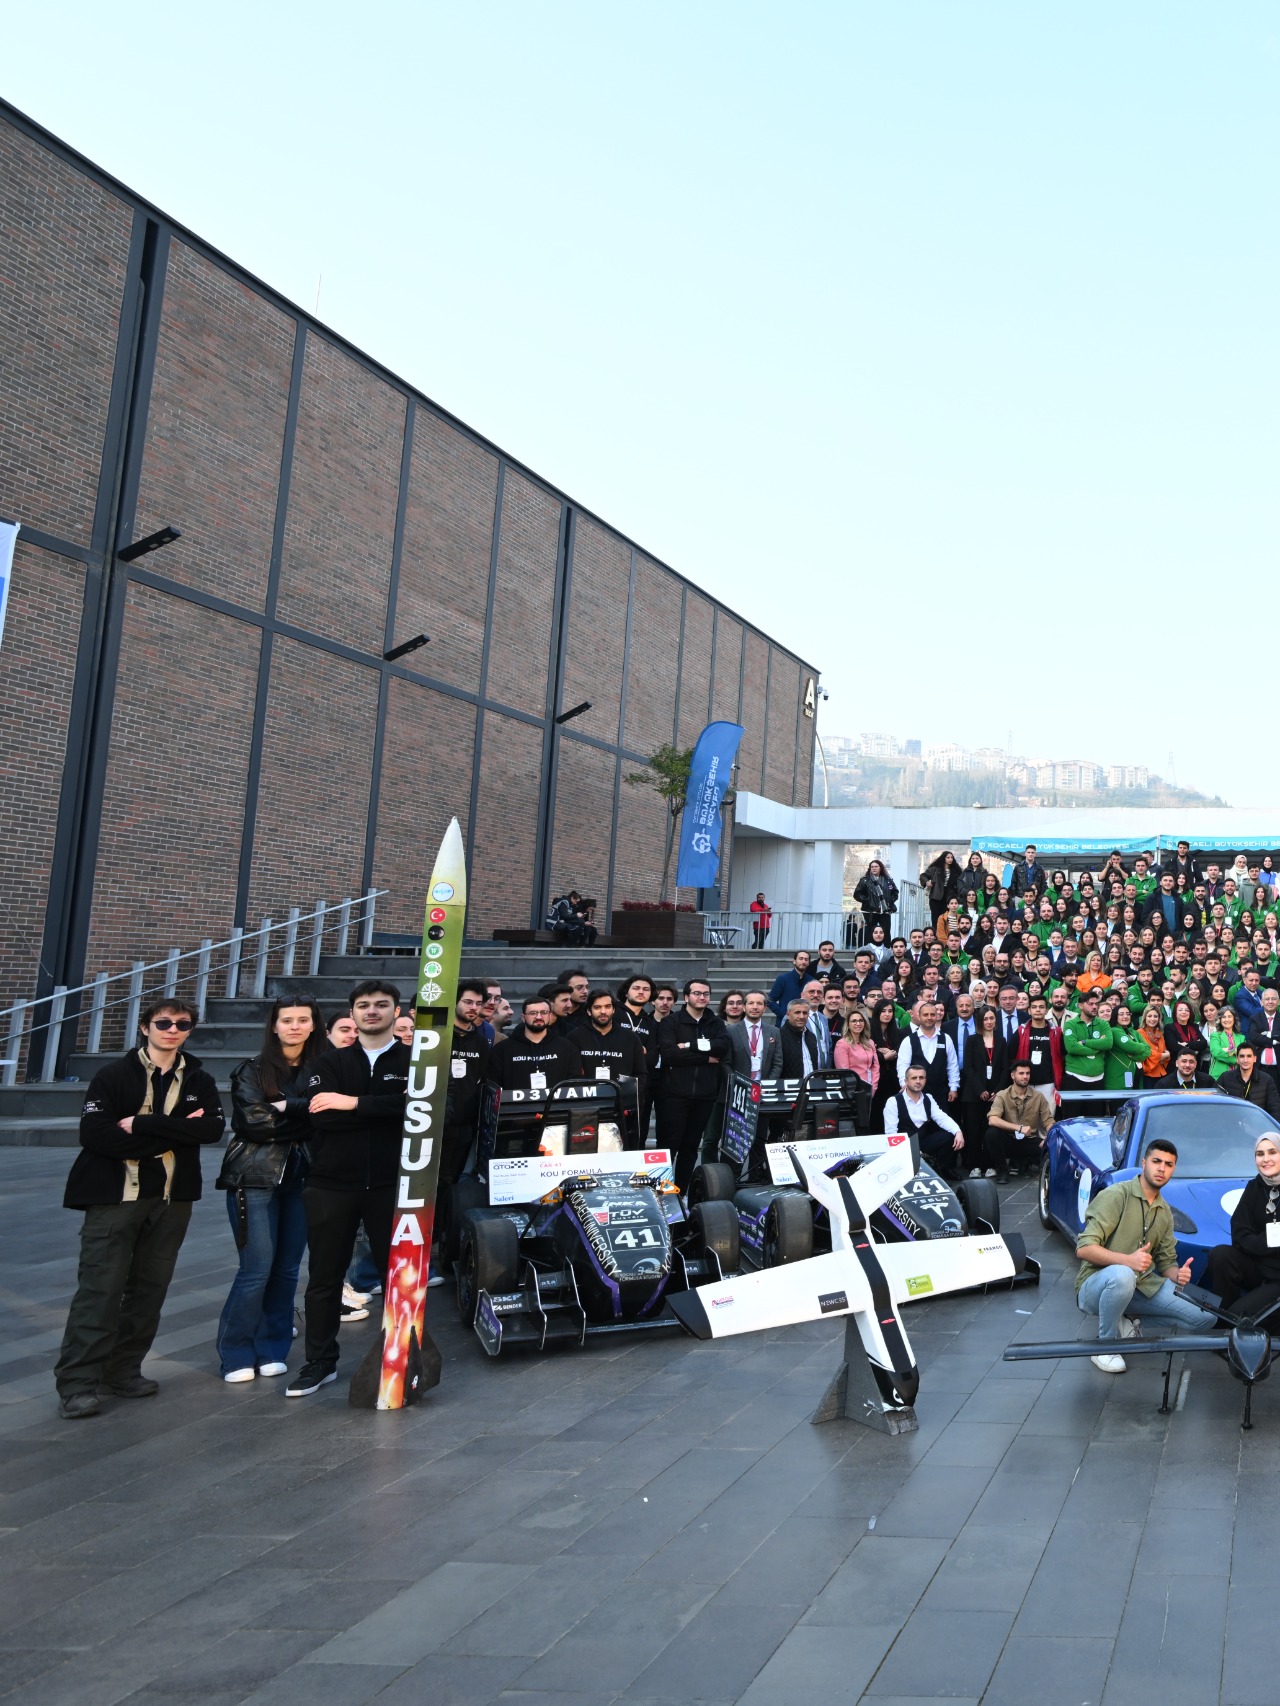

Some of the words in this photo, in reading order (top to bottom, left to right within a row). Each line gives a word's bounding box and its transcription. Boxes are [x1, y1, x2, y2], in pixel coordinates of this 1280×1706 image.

[804, 678, 815, 709] A
[512, 1055, 526, 1063] KOU
[732, 1084, 746, 1113] 141
[391, 1029, 440, 1246] PUSULA
[540, 1170, 559, 1178] KOU
[561, 1168, 603, 1177] FORMULA
[900, 1179, 950, 1199] 141
[911, 1196, 949, 1204] TESLA
[609, 1208, 645, 1217] TÜV
[583, 1217, 622, 1277] UNIVERSITY
[615, 1228, 660, 1248] 41
[493, 1294, 522, 1302] SKF
